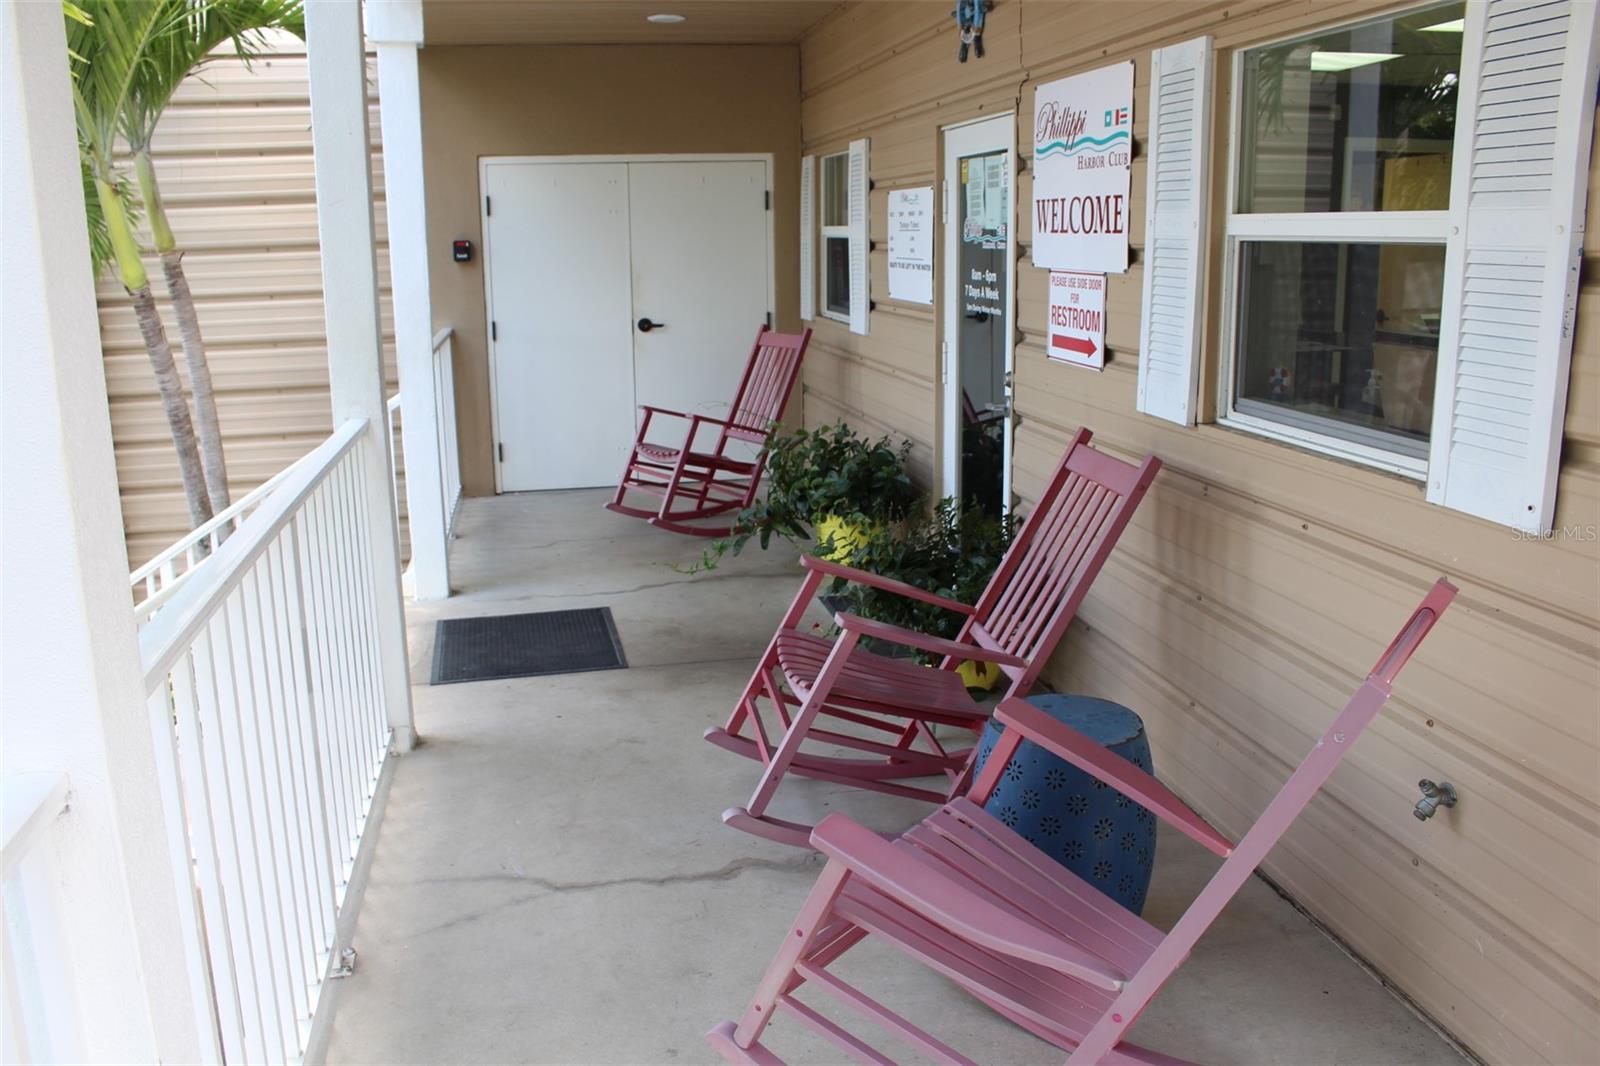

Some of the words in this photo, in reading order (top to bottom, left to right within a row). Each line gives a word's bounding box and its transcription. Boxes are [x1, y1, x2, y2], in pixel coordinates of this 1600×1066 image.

[1036, 101, 1087, 151] Phillippi
[1077, 155, 1105, 170] HARBOR
[1108, 151, 1129, 167] CLUB
[1036, 194, 1124, 235] WELCOME
[968, 284, 980, 300] Days
[985, 286, 1000, 301] Week
[1051, 275, 1067, 287] PLEASE
[1068, 277, 1077, 289] USE
[1077, 277, 1088, 290] SIDE
[1088, 279, 1102, 291] DOOR
[1070, 293, 1080, 304] FOR
[1051, 305, 1101, 332] RESTROOM
